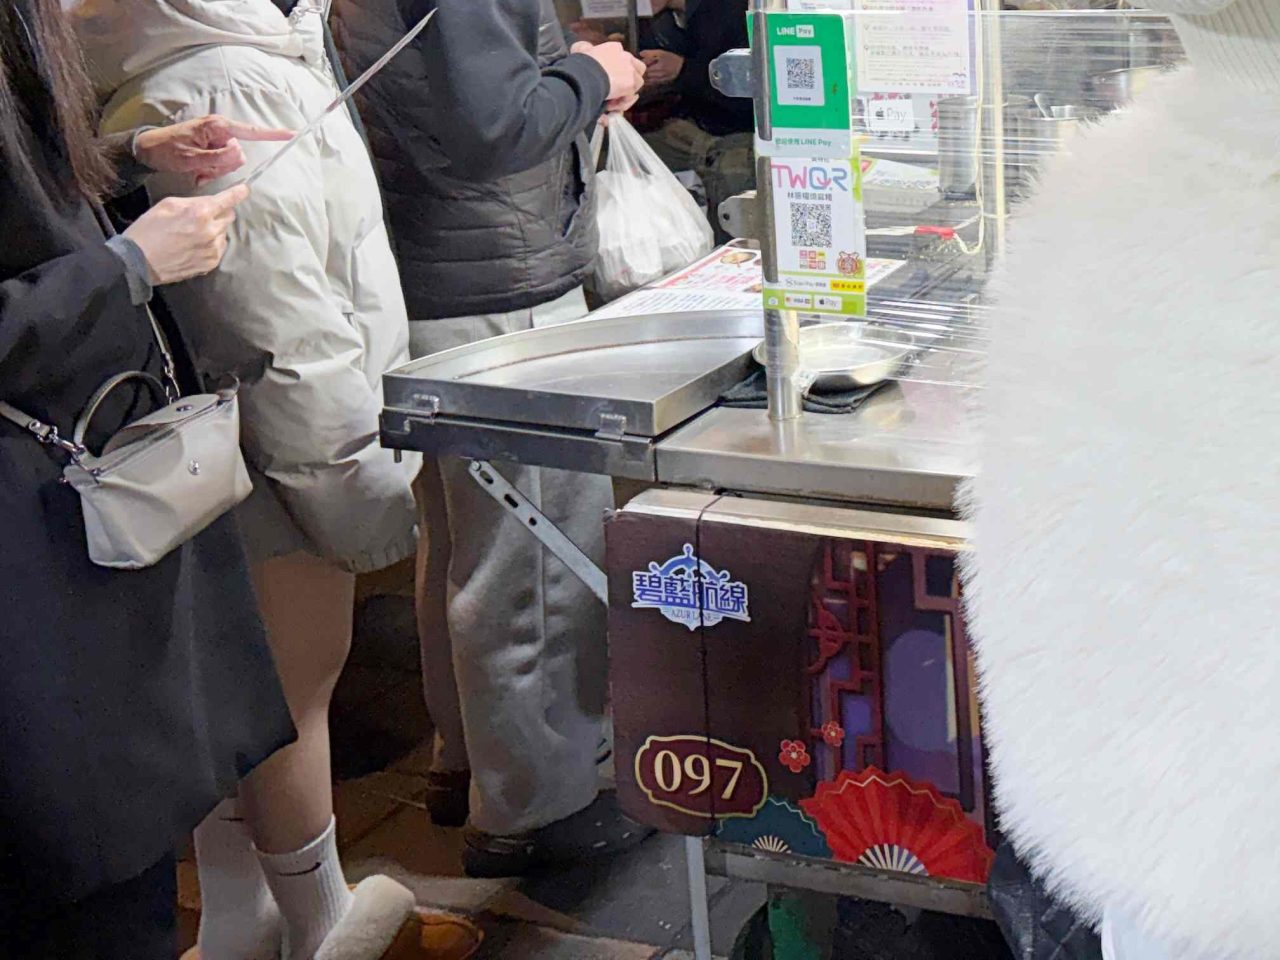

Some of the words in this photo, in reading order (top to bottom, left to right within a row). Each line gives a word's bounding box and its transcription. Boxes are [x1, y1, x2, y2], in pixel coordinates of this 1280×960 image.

[776, 27, 795, 36] LINE
[797, 27, 812, 37] Pay
[634, 573, 746, 613] 碧藍航線
[654, 750, 743, 800] 097
